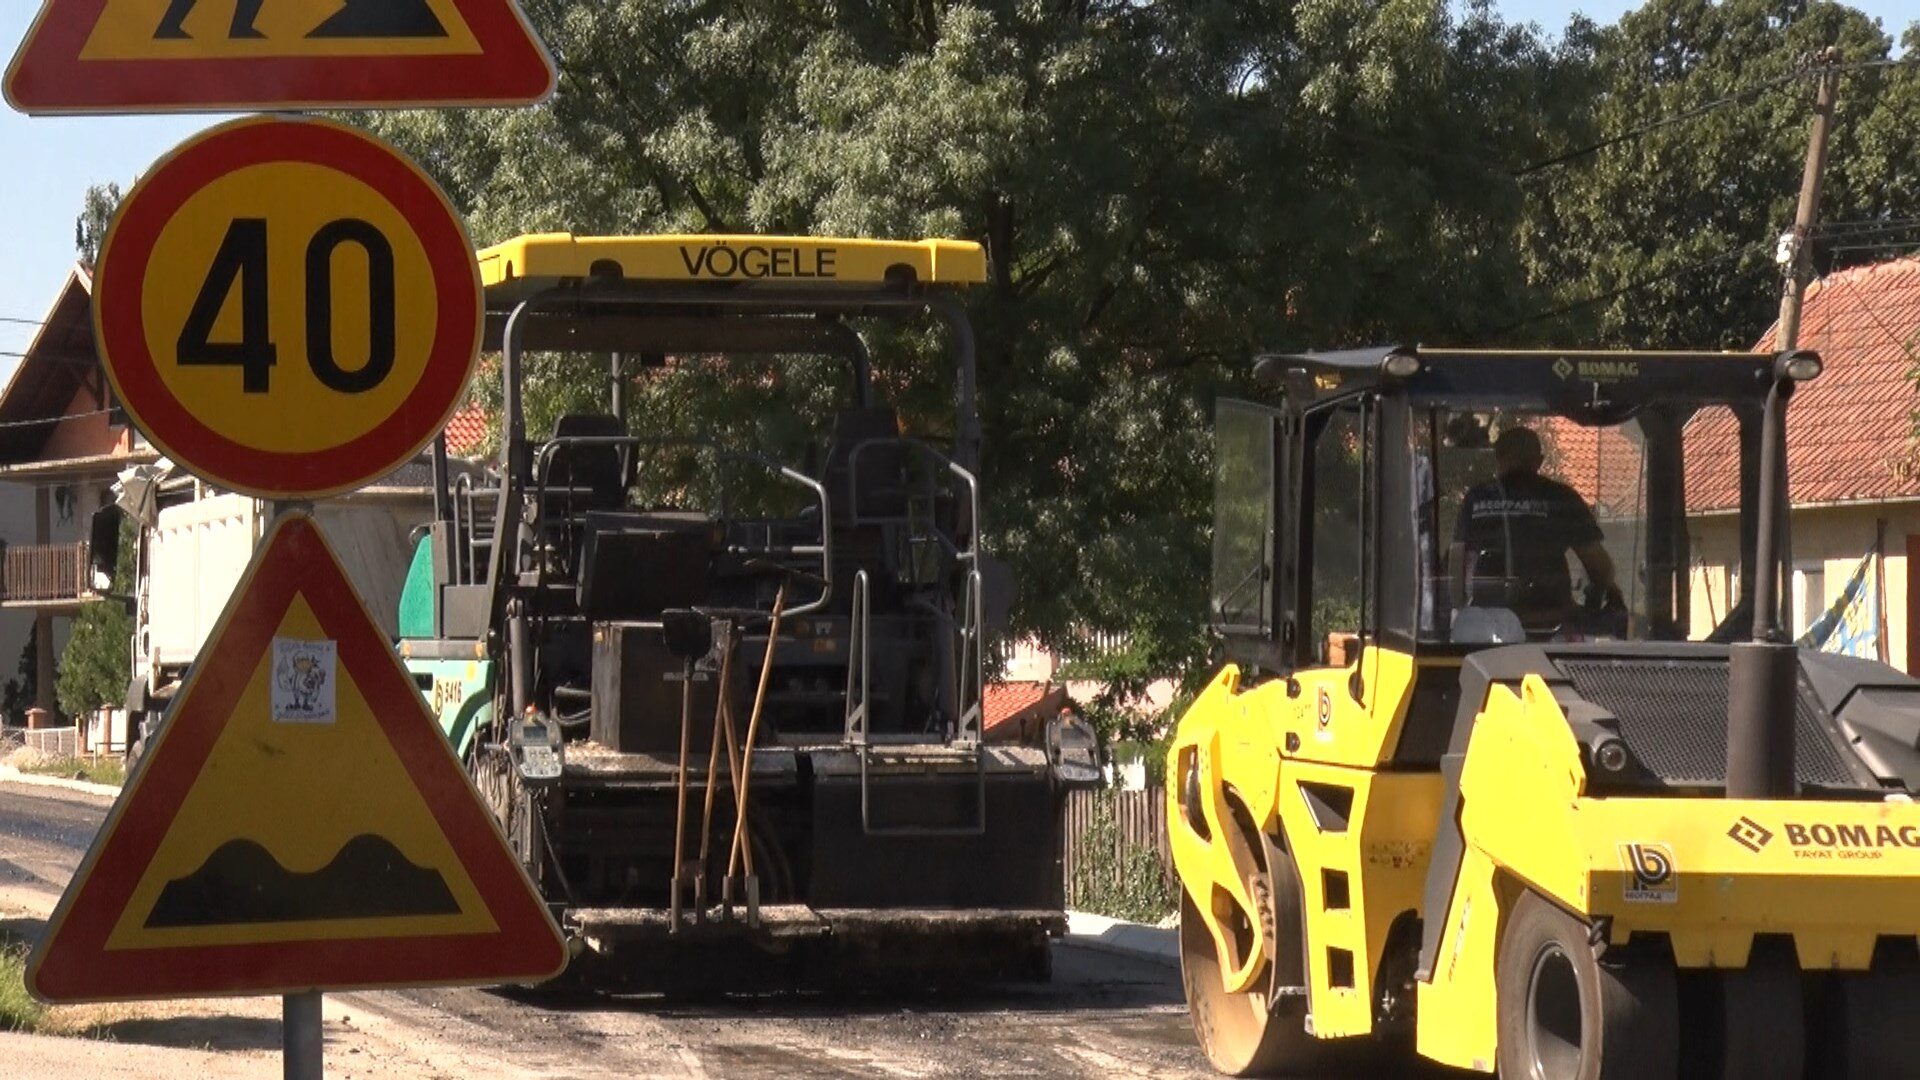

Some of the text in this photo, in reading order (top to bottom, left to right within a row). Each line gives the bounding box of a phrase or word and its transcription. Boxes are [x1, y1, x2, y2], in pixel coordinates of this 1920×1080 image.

[679, 240, 837, 277] VÖGELE
[176, 218, 396, 393] 40
[1578, 361, 1639, 376] BOMAG
[1784, 823, 1920, 848] BOMAG
[1794, 850, 1882, 860] FAYAT GROUP
